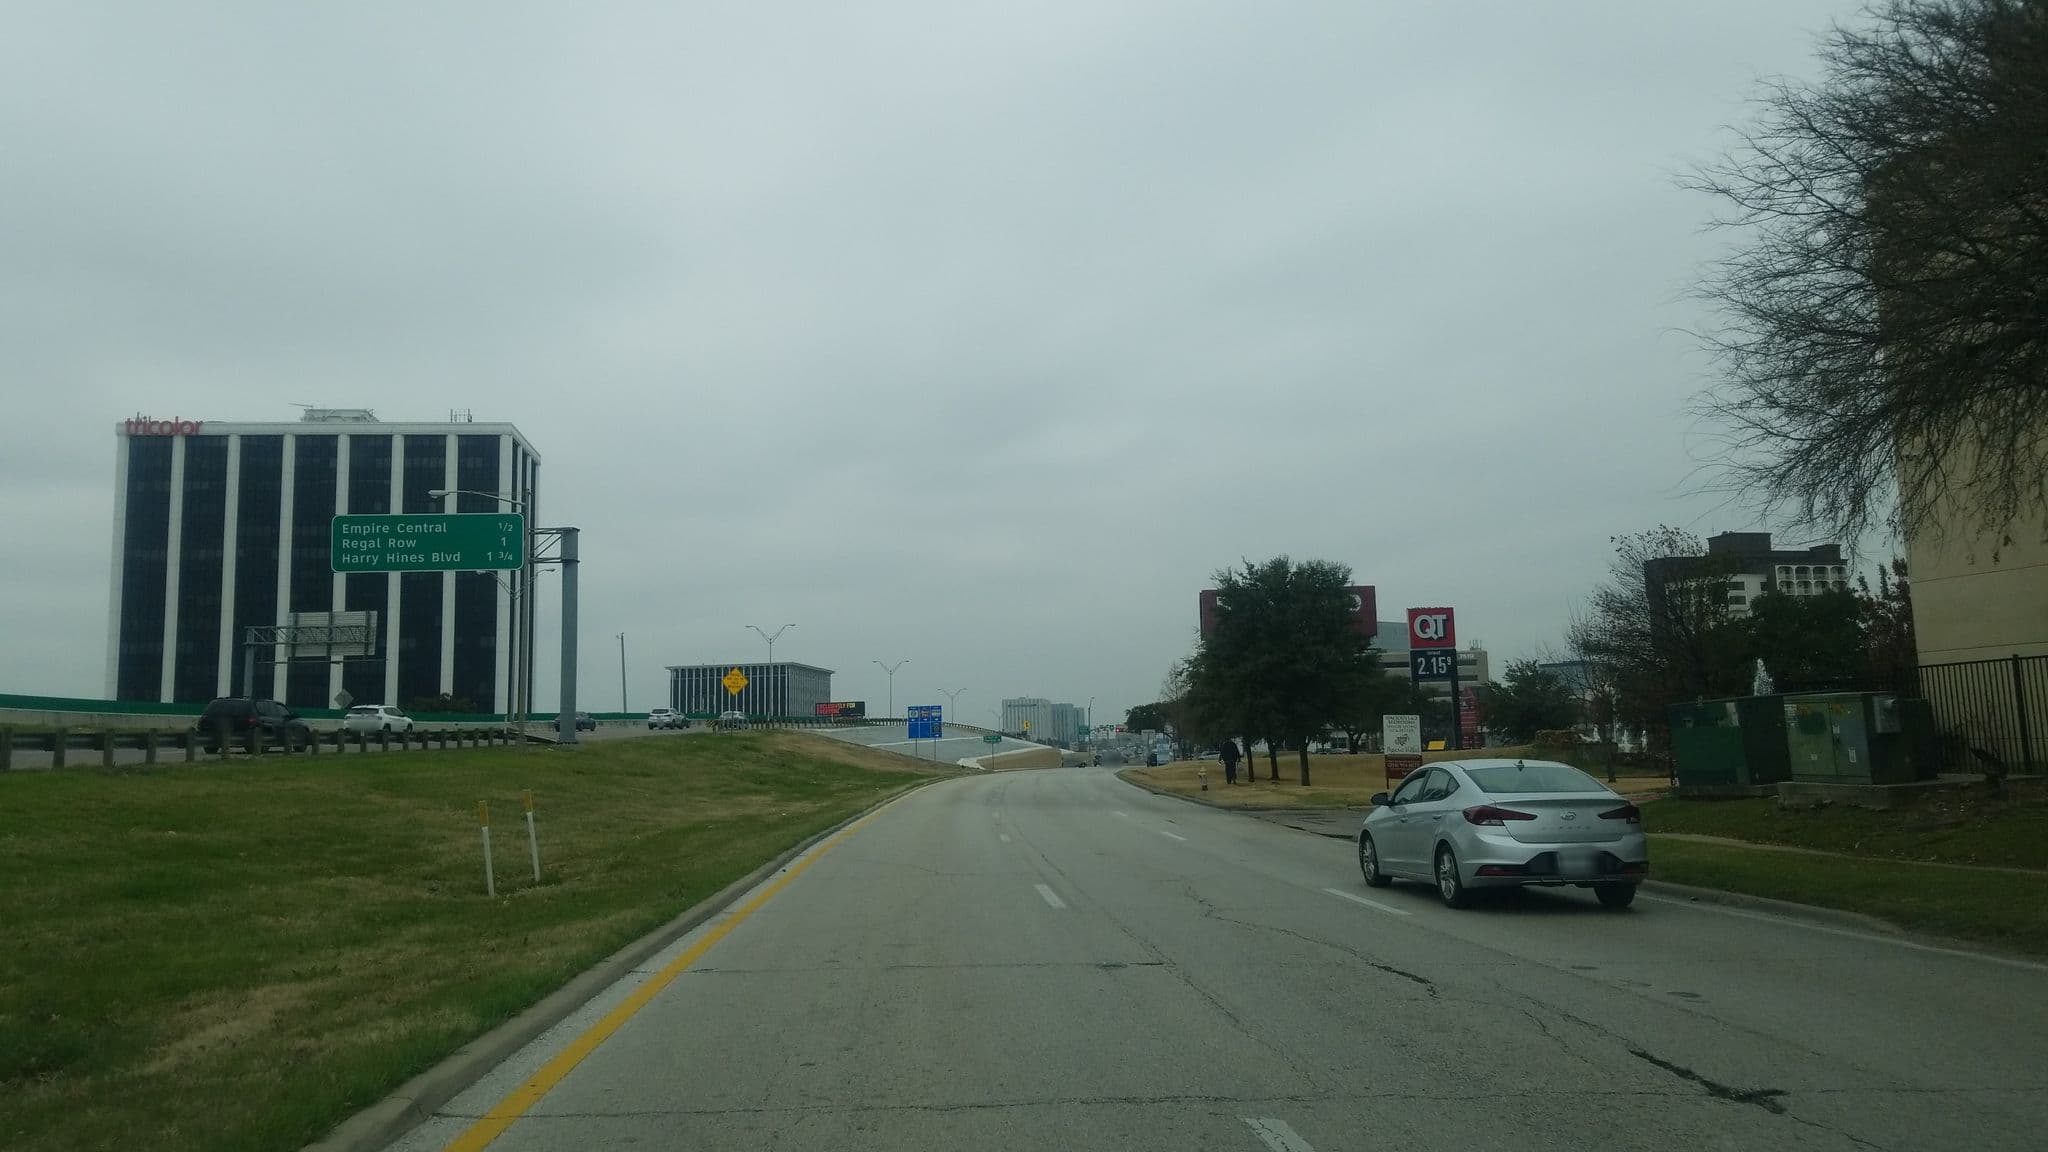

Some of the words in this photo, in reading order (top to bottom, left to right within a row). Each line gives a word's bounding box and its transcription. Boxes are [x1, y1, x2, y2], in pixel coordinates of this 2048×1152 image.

[125, 416, 203, 435] tricolor
[342, 523, 390, 535] Empire
[397, 522, 447, 533] Central
[342, 538, 380, 551] Regal
[388, 537, 417, 548] Row
[501, 537, 506, 546] 1
[342, 553, 379, 565] Harry
[387, 552, 425, 563] Hines
[432, 551, 461, 563] Blvd
[487, 552, 492, 561] 1
[1413, 614, 1447, 640] QT
